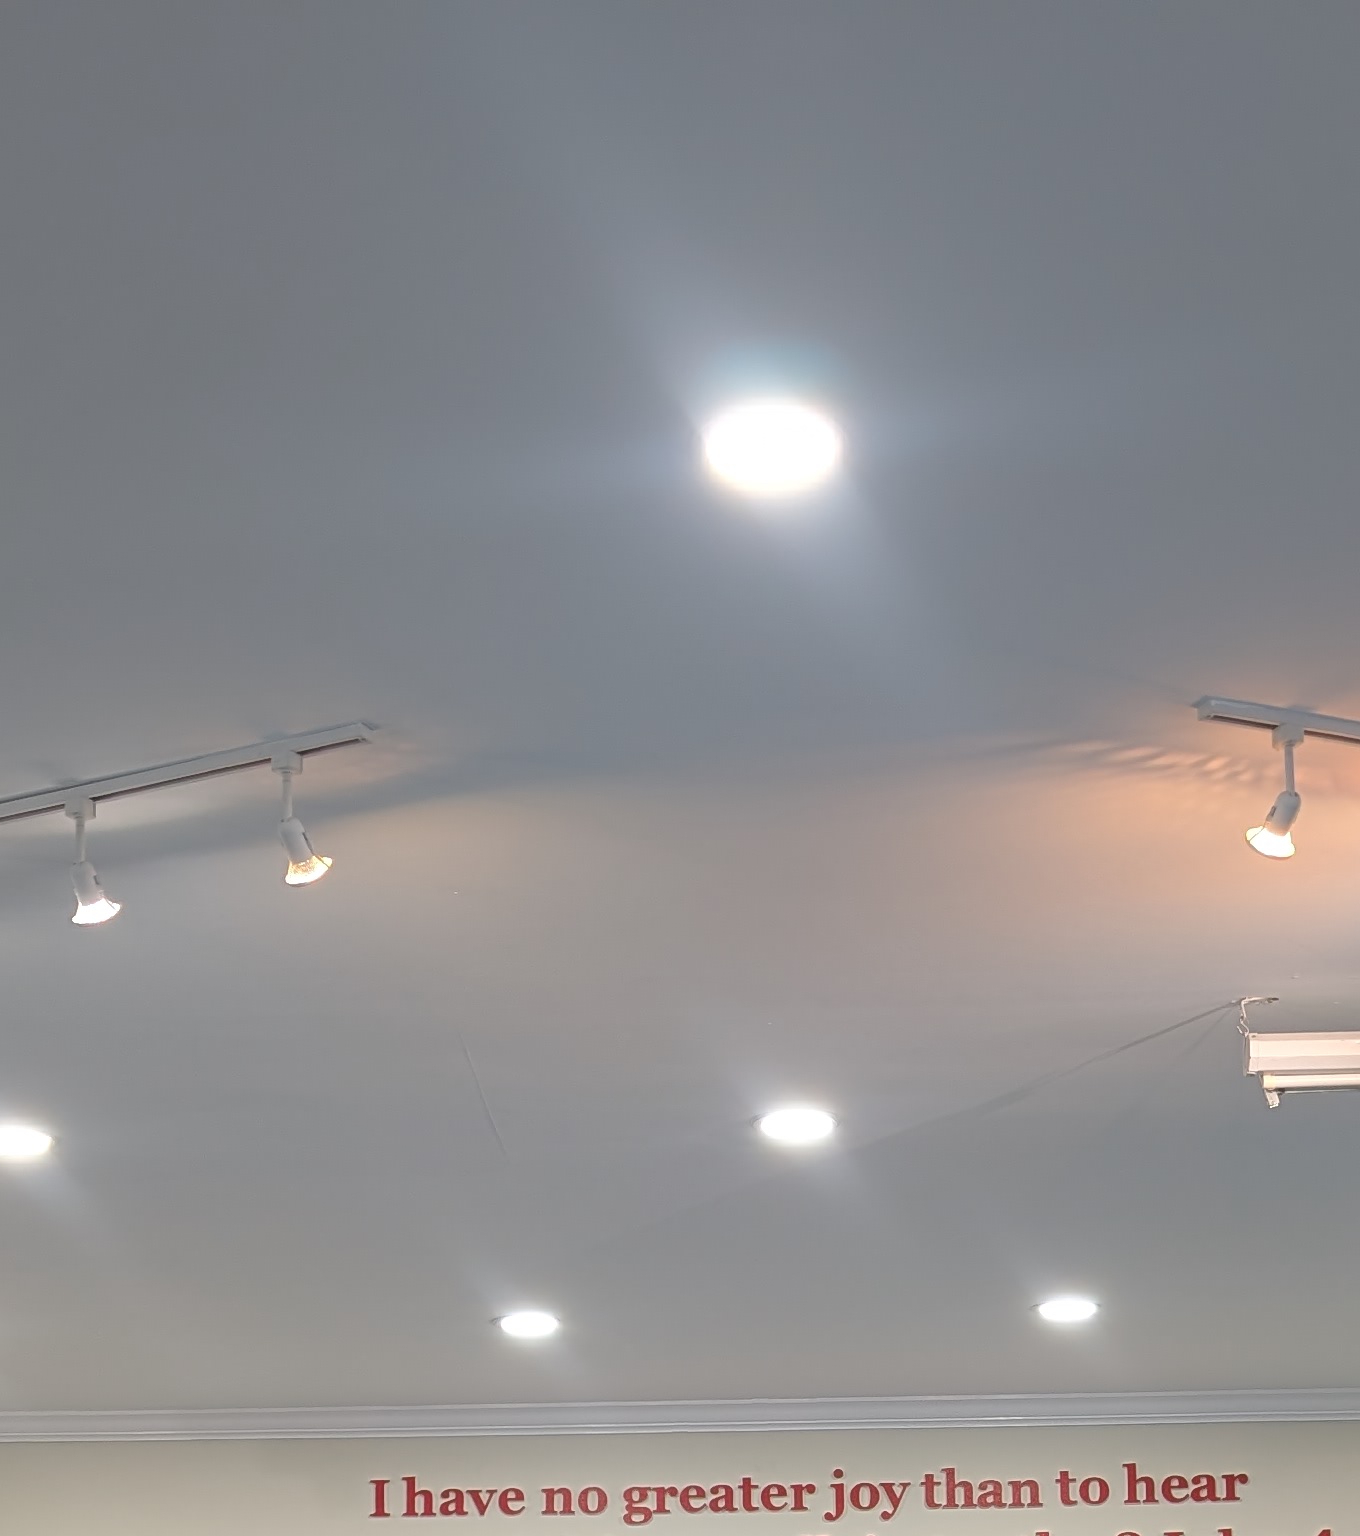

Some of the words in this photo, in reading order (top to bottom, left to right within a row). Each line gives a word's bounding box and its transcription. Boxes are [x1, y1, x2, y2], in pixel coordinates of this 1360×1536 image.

[369, 1478, 391, 1518] I
[401, 1475, 526, 1518] have
[541, 1485, 608, 1516] no
[622, 1476, 816, 1525] greater
[823, 1468, 911, 1521] joy
[921, 1467, 1043, 1509] than
[1055, 1470, 1110, 1507] to
[1123, 1463, 1249, 1505] hear
